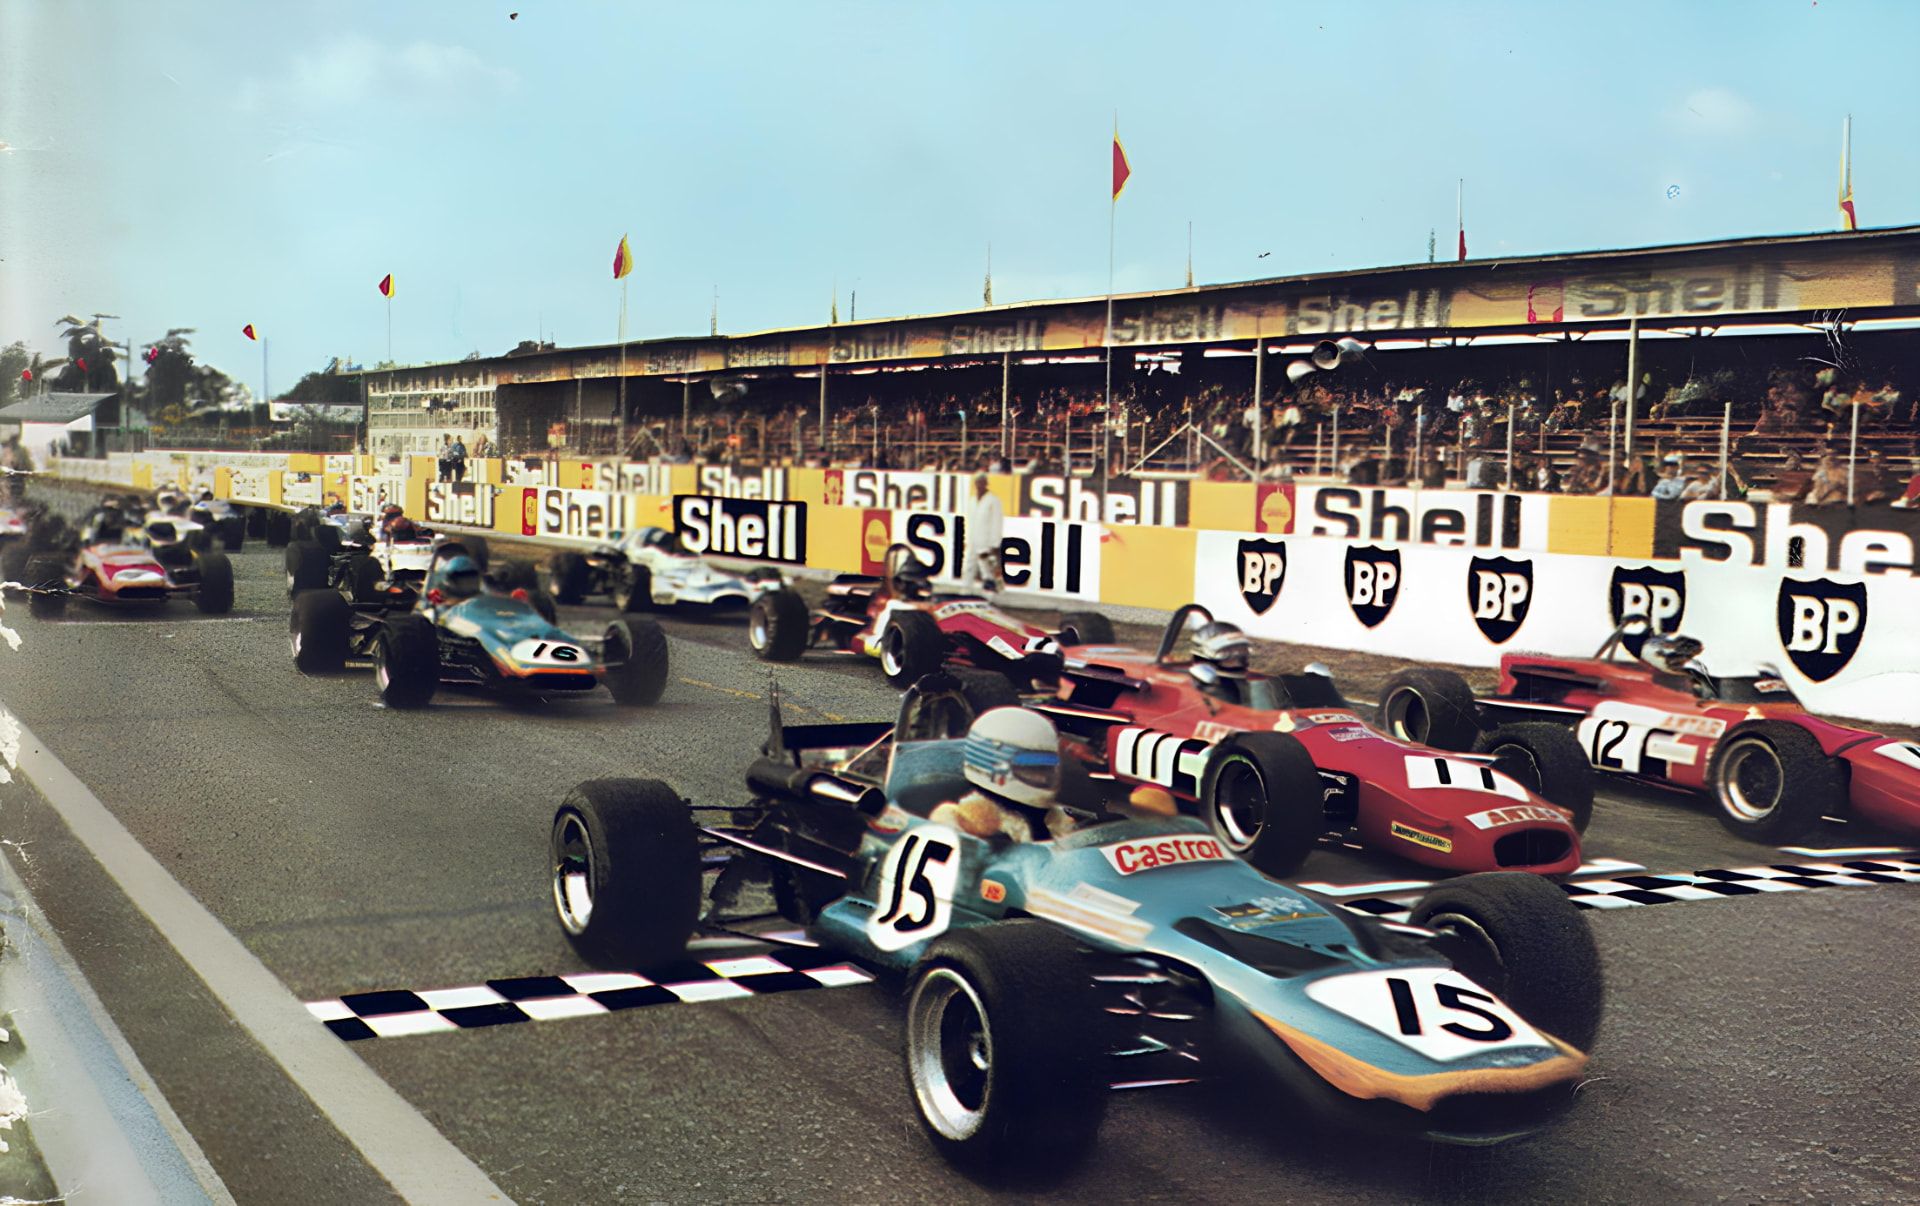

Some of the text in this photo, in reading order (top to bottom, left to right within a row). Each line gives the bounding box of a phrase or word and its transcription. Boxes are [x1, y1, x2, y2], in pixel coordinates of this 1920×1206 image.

[600, 463, 661, 494] Shell
[700, 465, 783, 500] Shell
[854, 471, 957, 512] Shell
[1029, 476, 1176, 526] Shell
[428, 482, 494, 528] Shell
[546, 489, 625, 538] Shell
[680, 498, 797, 560] Shell
[1312, 487, 1522, 549] Shell
[1242, 551, 1283, 595] BP
[1352, 560, 1397, 607] BP
[1475, 570, 1529, 622] BP
[1620, 582, 1681, 635] BP
[1787, 594, 1860, 655] BP
[532, 642, 579, 661] 16
[1592, 719, 1630, 769] 12
[1434, 758, 1496, 790] 11
[1115, 840, 1224, 873] Castrol
[878, 834, 954, 932] 15
[1387, 978, 1514, 1042] 15
